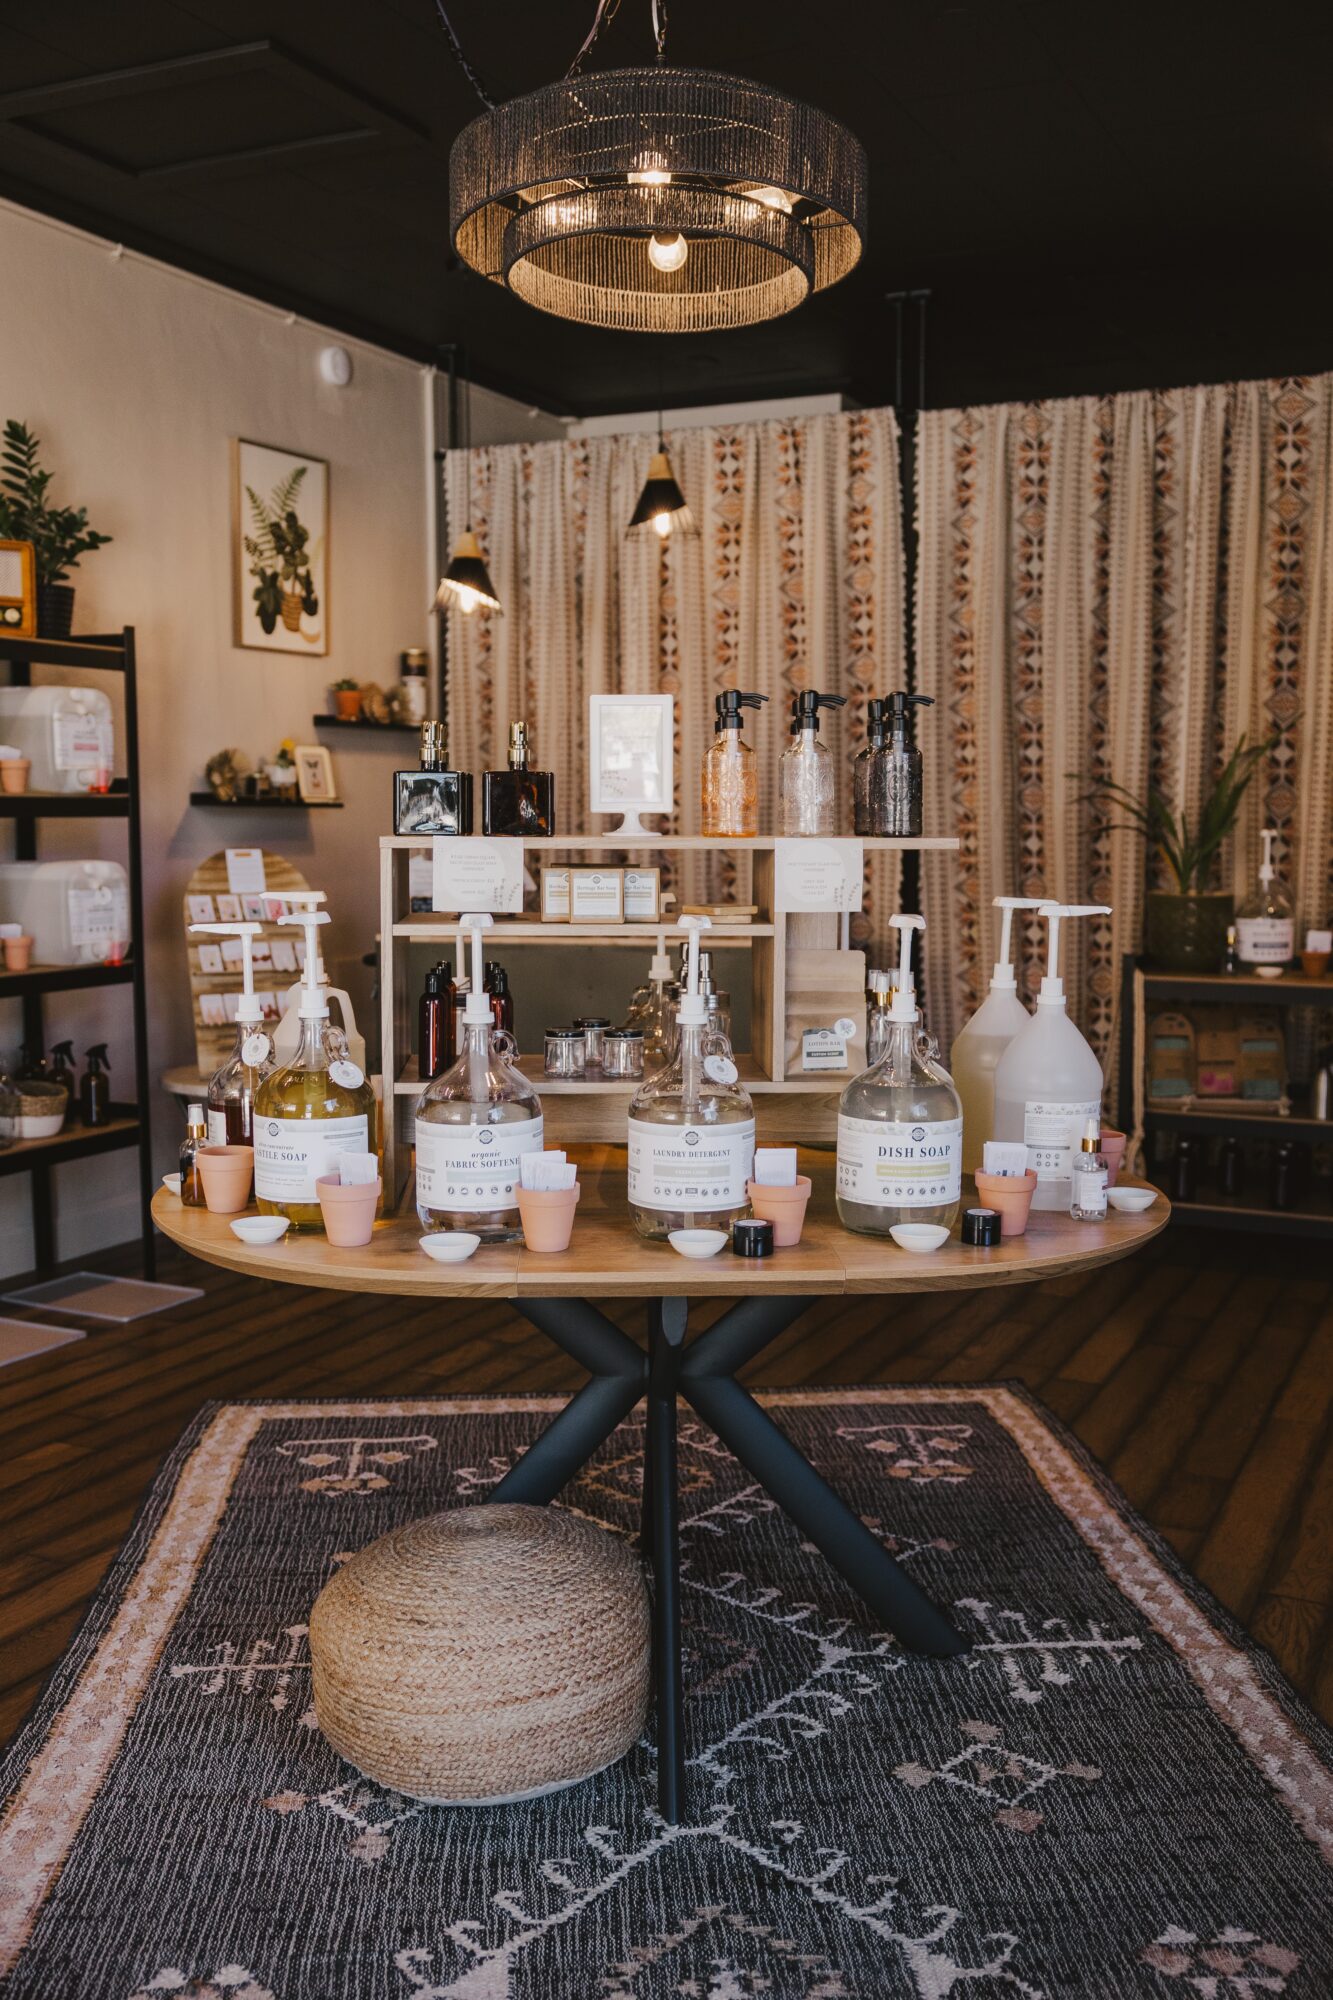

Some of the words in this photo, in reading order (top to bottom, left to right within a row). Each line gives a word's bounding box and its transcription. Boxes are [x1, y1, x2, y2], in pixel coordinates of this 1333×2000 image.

[255, 1147, 279, 1160] ASTILE
[281, 1151, 308, 1161] SOAP
[471, 1149, 502, 1159] organic
[653, 1149, 687, 1158] LAUNDRY
[689, 1149, 731, 1158] DETERGENT
[878, 1145, 914, 1158] DISH
[920, 1145, 951, 1158] SOAP
[445, 1160, 477, 1169] FABRIC
[480, 1157, 520, 1169] SOFTENE
